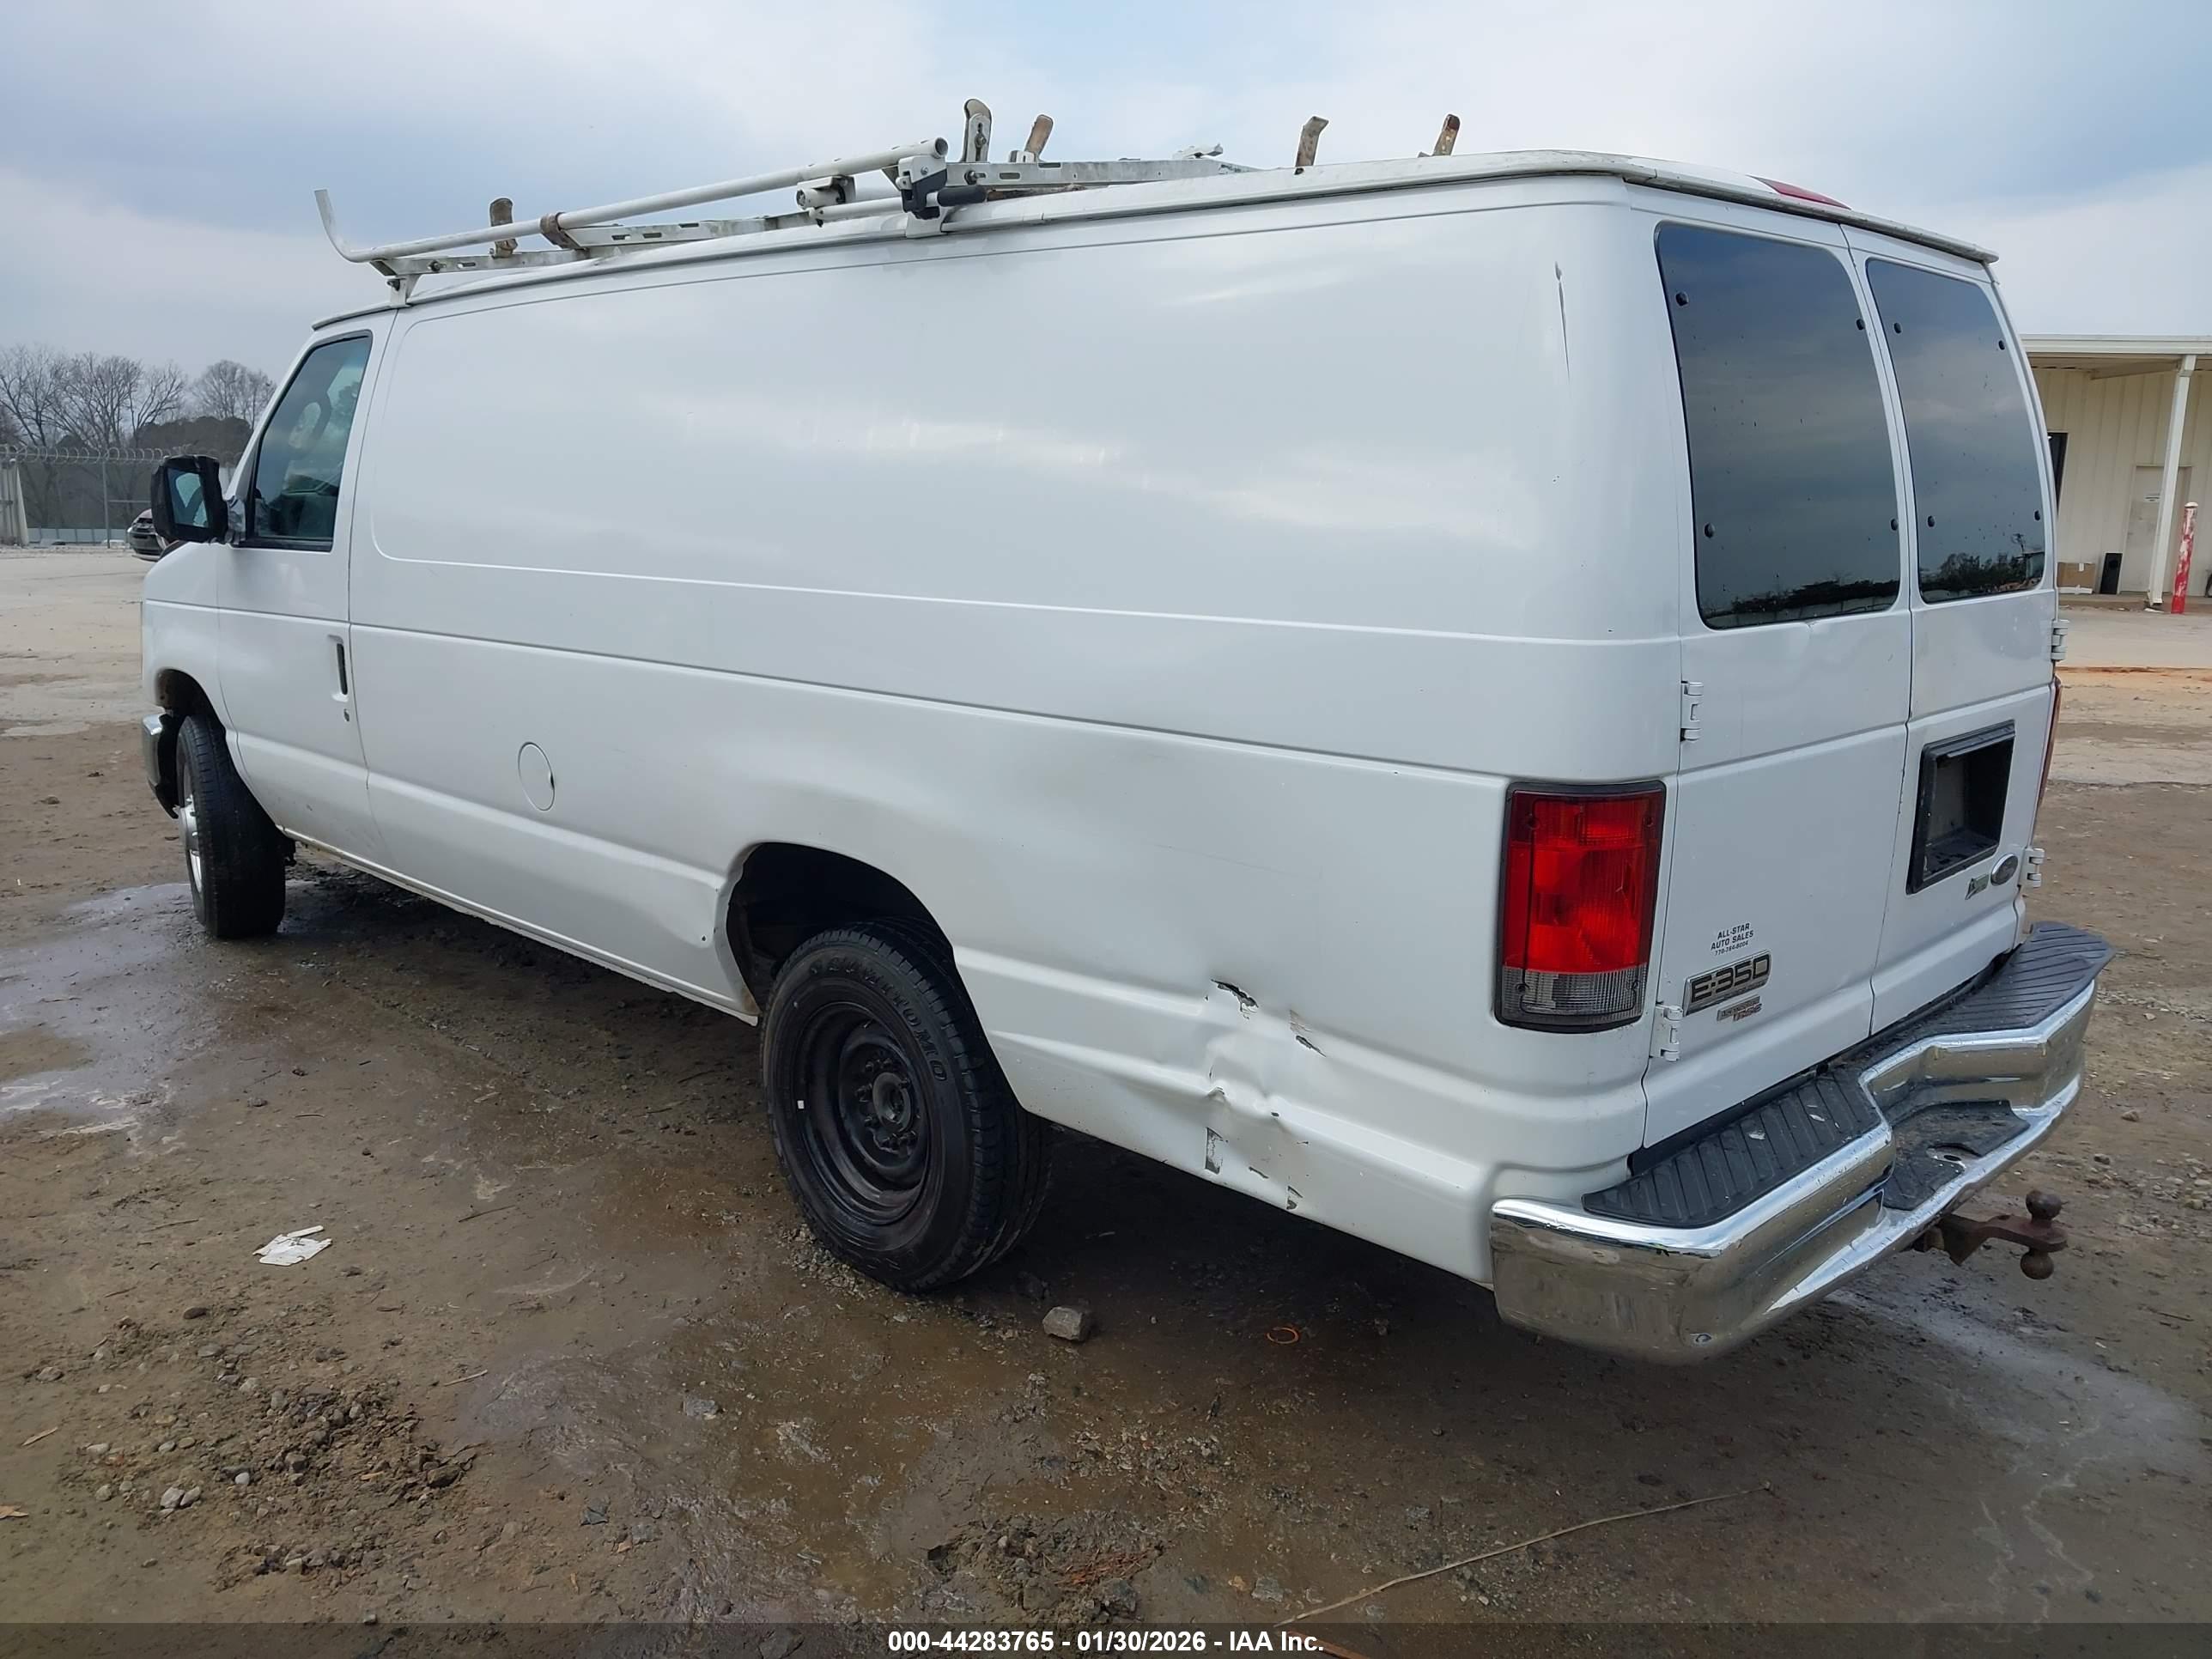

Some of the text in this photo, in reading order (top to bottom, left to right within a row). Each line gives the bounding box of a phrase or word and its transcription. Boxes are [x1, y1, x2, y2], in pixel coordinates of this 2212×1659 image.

[1717, 923, 1750, 939] ALL-STAR
[1711, 930, 1753, 951] AUTO SALES
